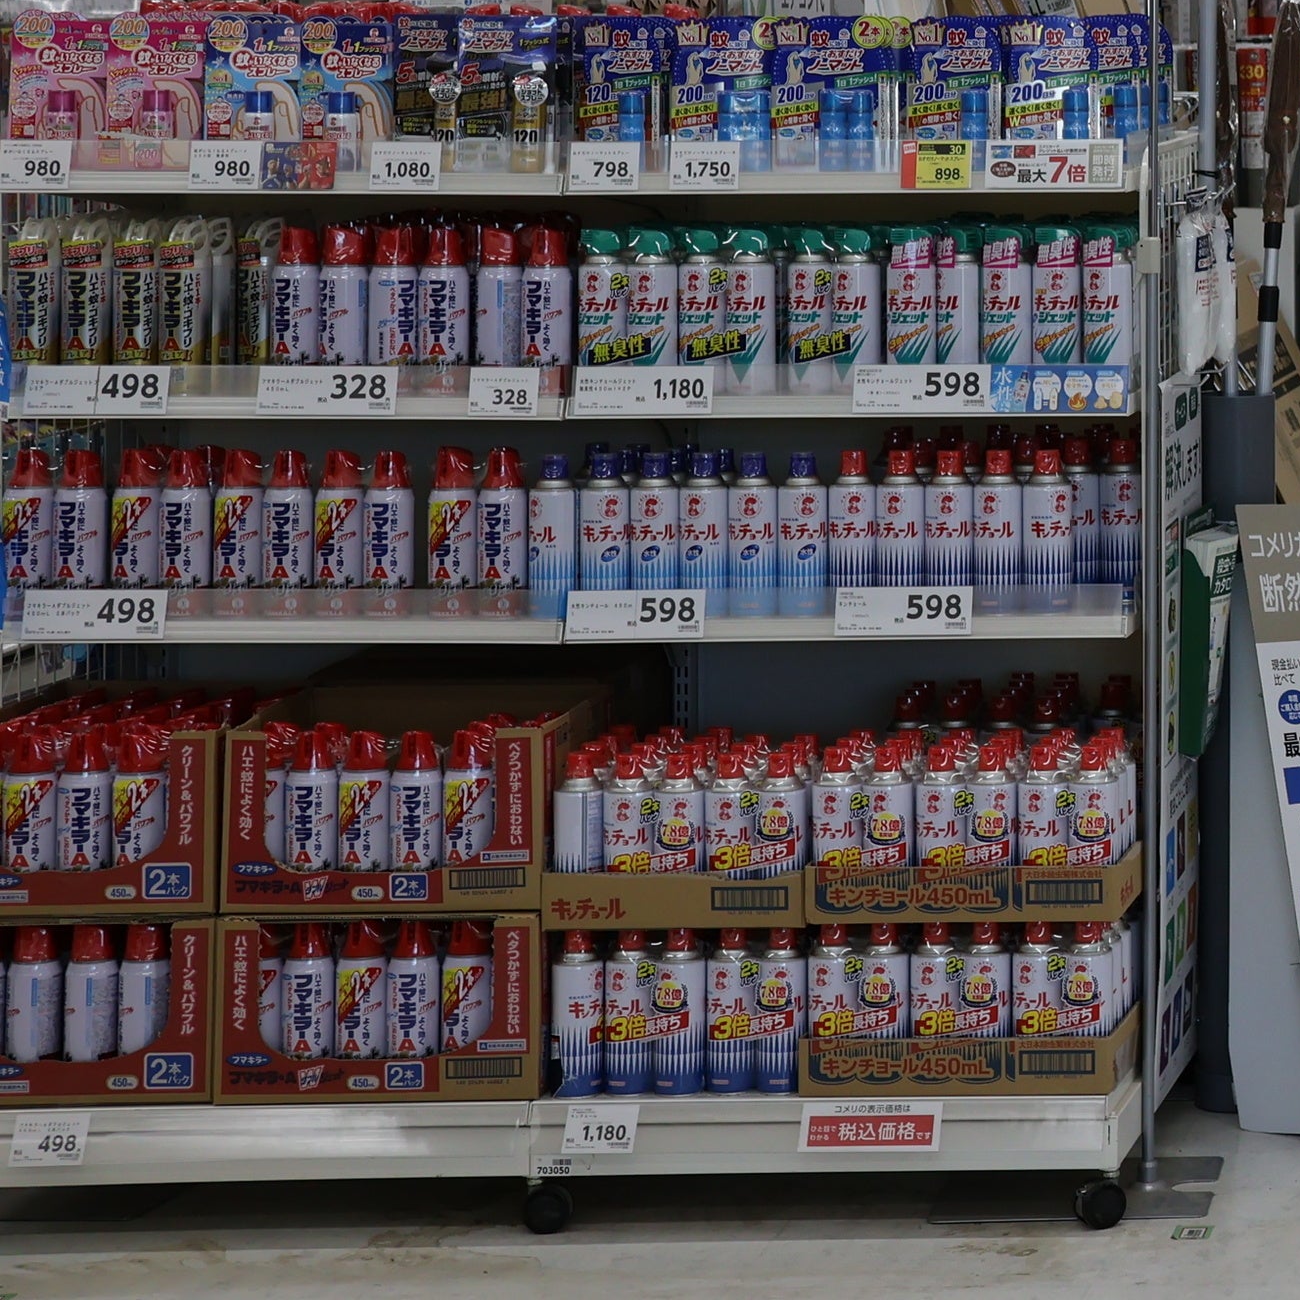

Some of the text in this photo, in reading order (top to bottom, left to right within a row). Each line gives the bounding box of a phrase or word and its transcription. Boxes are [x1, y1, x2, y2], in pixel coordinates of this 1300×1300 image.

[24, 160, 61, 176] 980
[215, 160, 250, 176] 980
[385, 162, 430, 178] 1,080
[593, 161, 628, 177] 798
[685, 161, 730, 178] 1,750
[935, 167, 960, 180] 898
[101, 373, 160, 398] 498
[330, 374, 387, 399] 328
[653, 378, 704, 400] 1,180
[924, 372, 980, 397] 598
[97, 598, 155, 624] 498
[639, 597, 695, 623] 598
[906, 594, 961, 620] 598
[551, 898, 626, 921] キンチョール
[38, 1134, 76, 1152] 498
